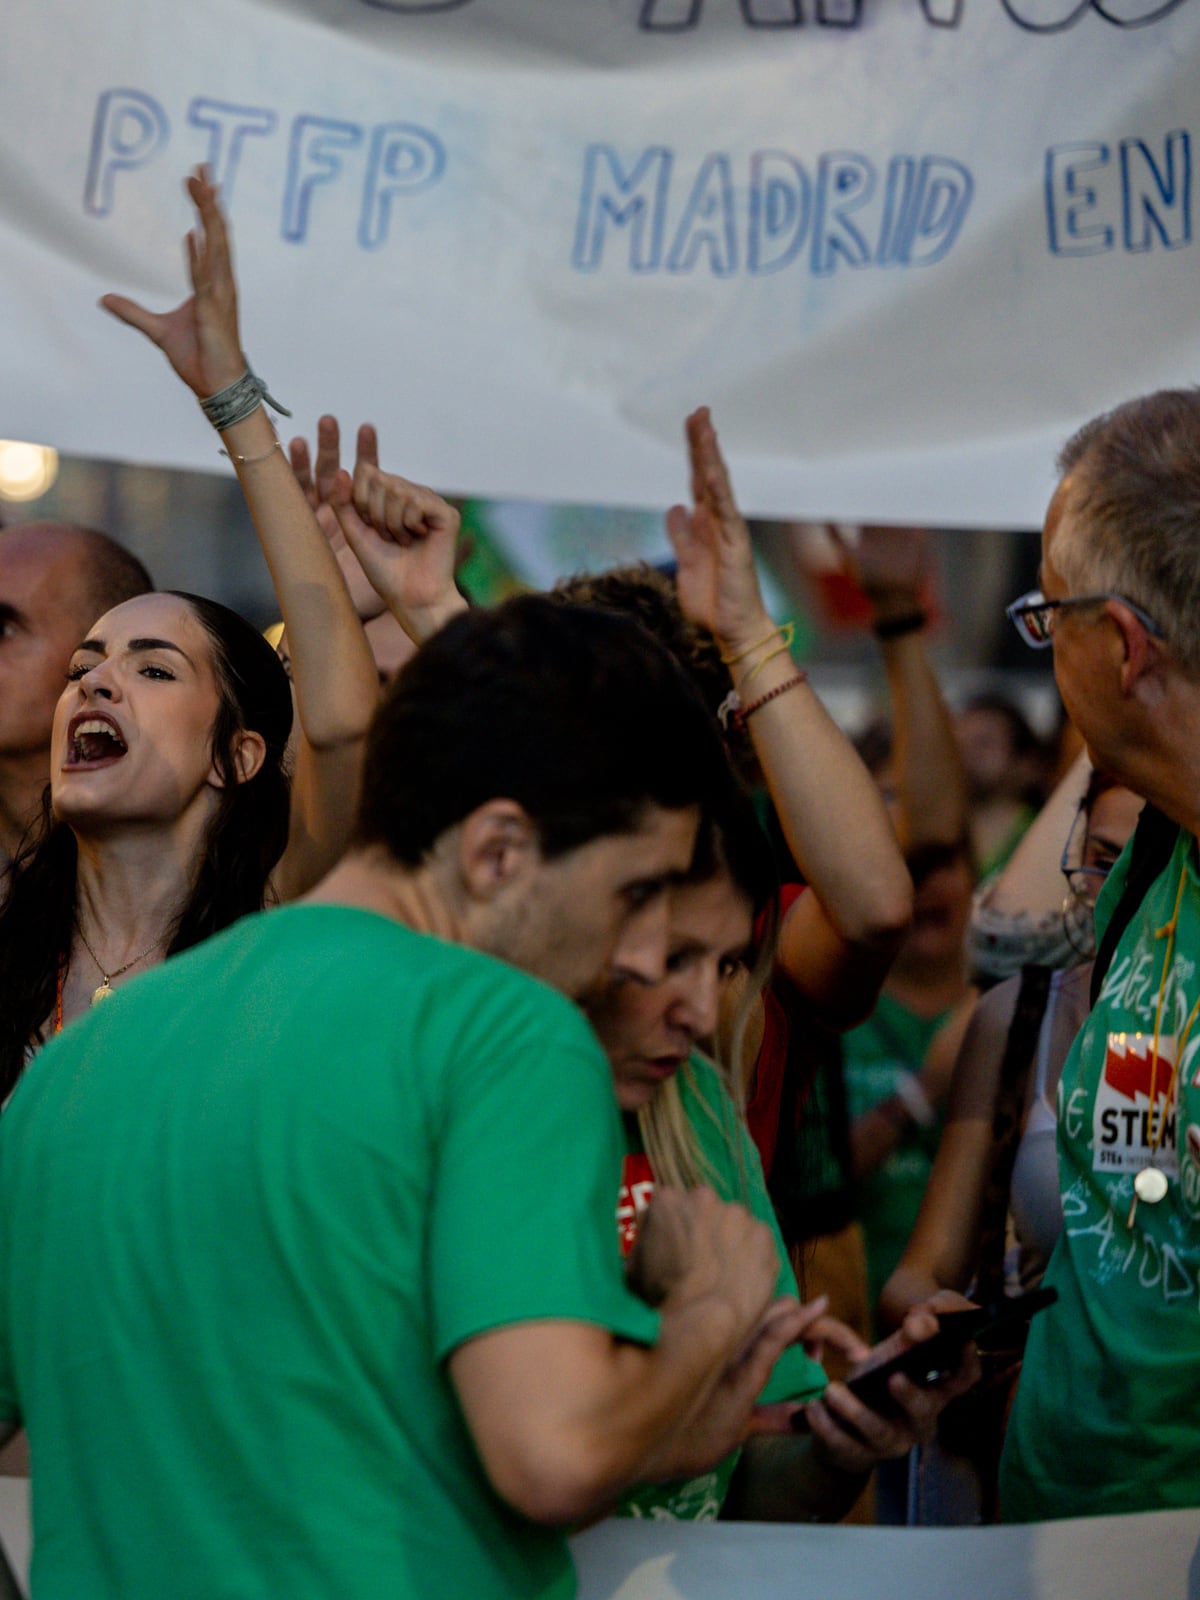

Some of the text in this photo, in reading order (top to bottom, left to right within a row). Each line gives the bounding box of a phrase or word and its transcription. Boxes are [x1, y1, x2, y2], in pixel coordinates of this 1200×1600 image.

[83, 87, 1193, 277] PTFP MADRID EN
